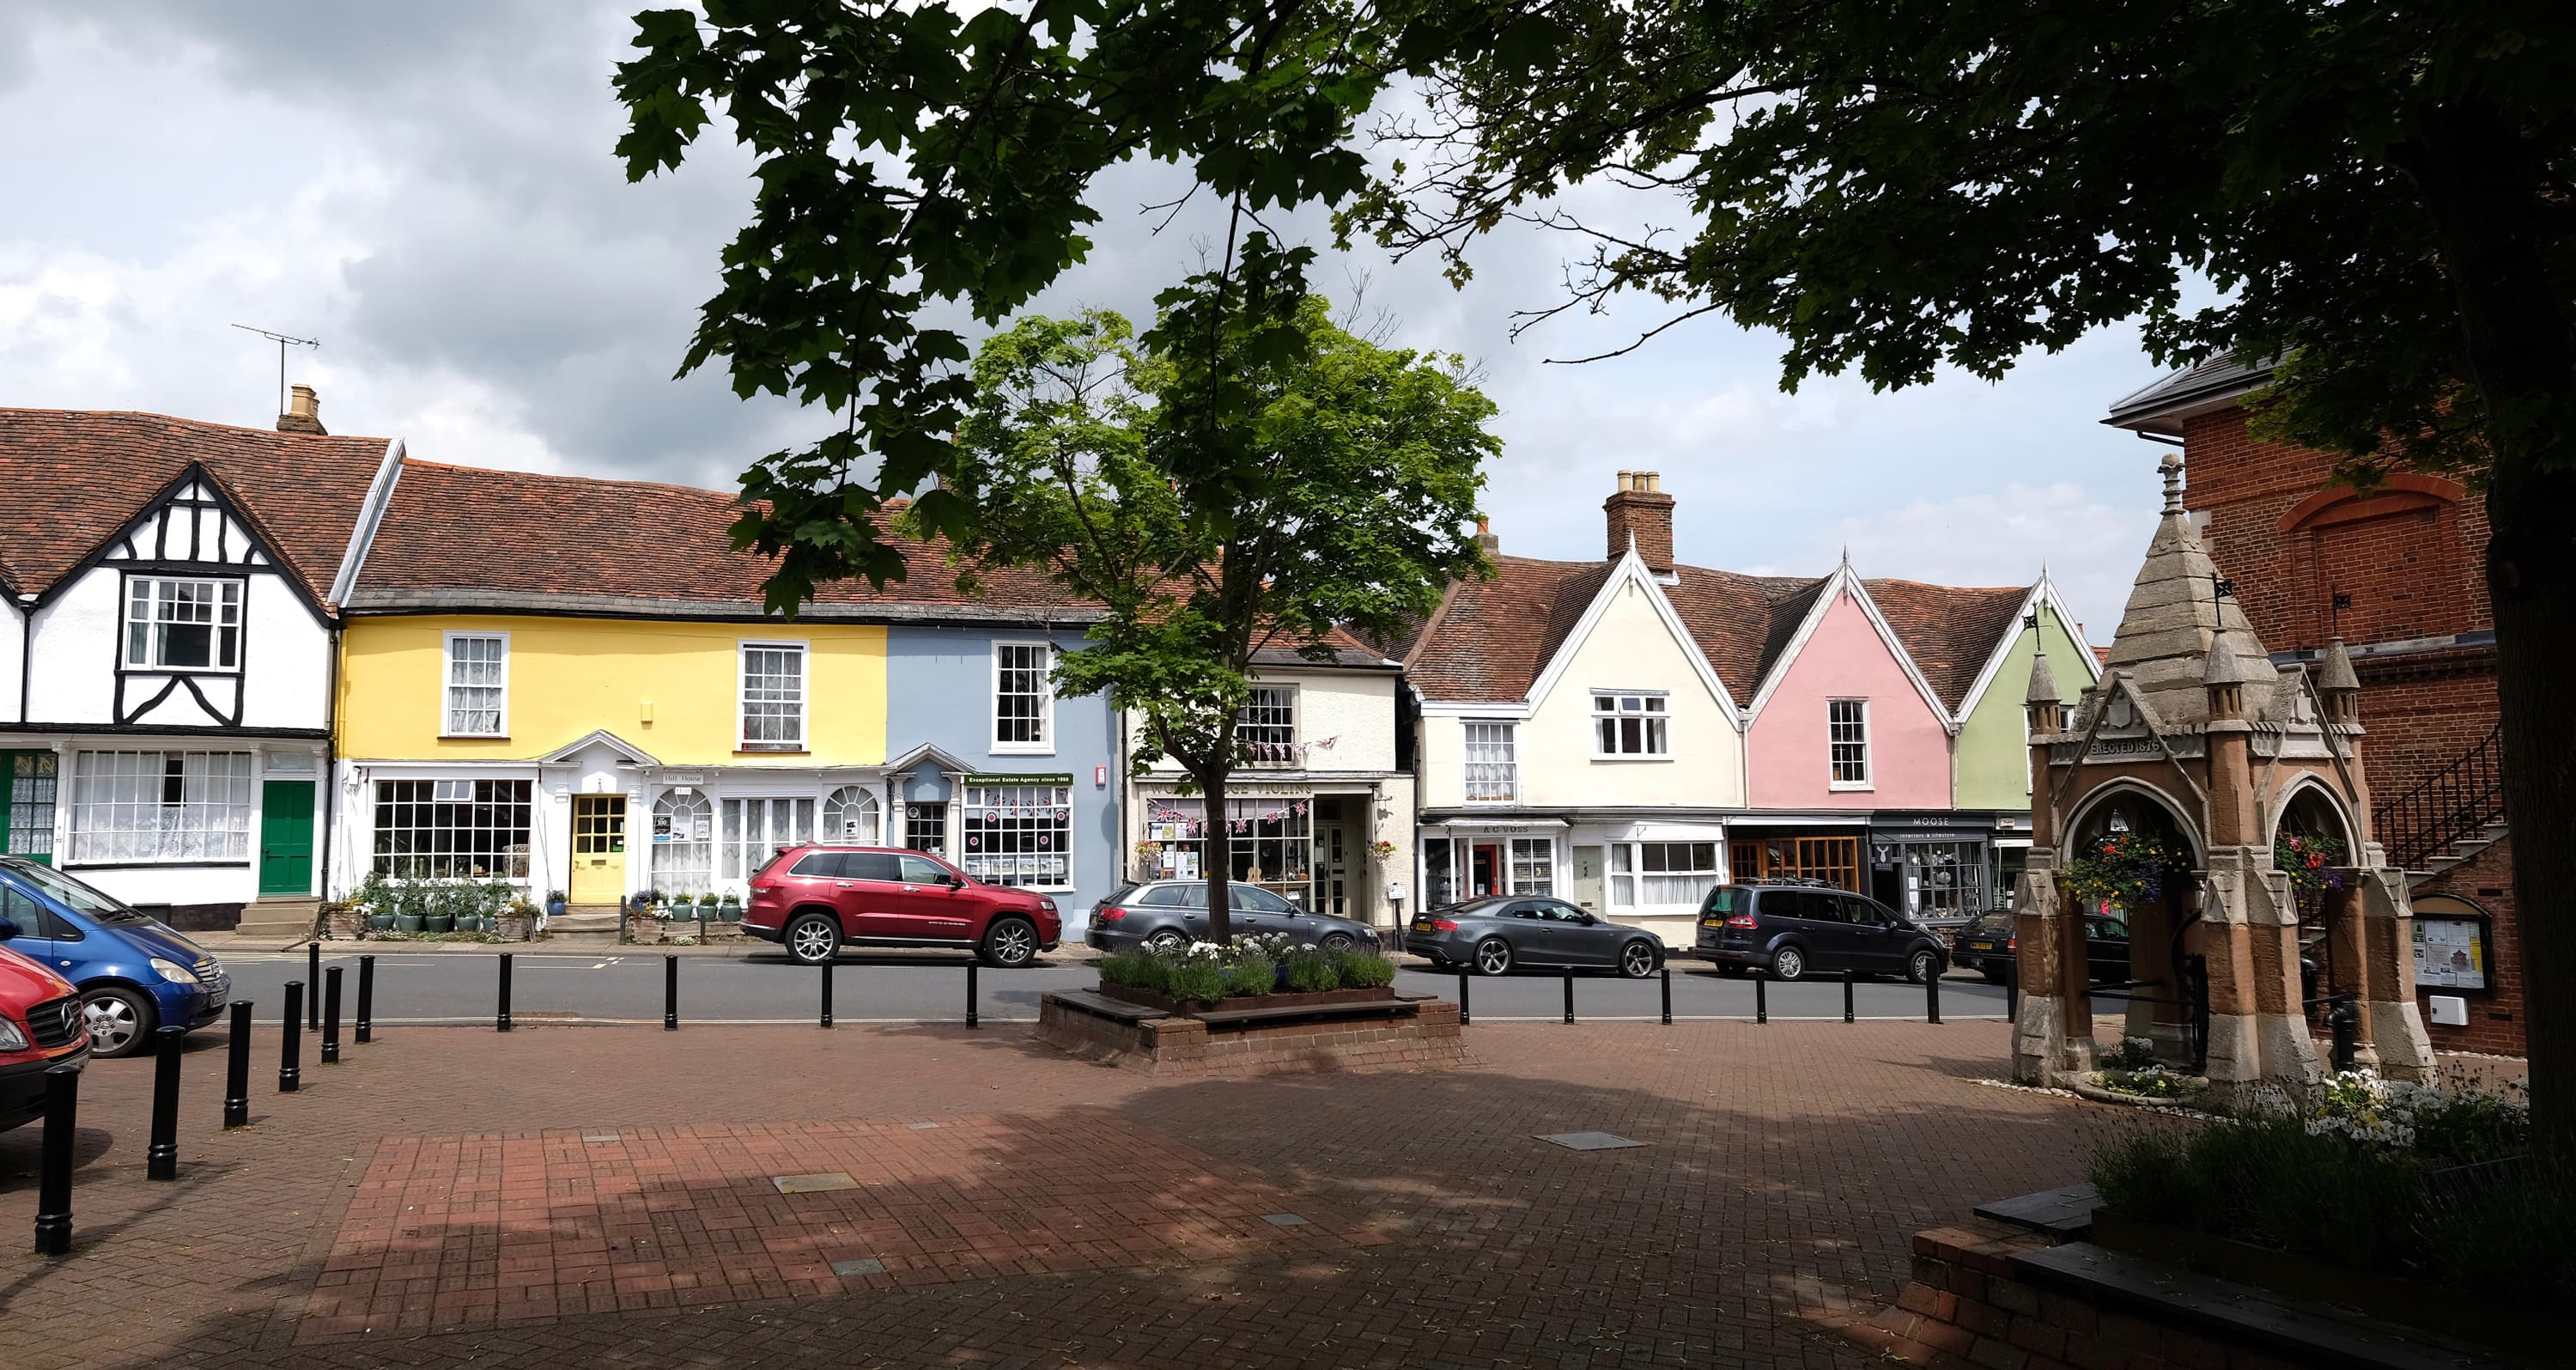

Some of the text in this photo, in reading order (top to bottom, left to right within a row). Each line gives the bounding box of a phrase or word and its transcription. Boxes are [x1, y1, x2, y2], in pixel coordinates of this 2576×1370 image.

[2091, 740, 2160, 755] ERECTED 1876
[1256, 782, 1312, 795] VIOLINS
